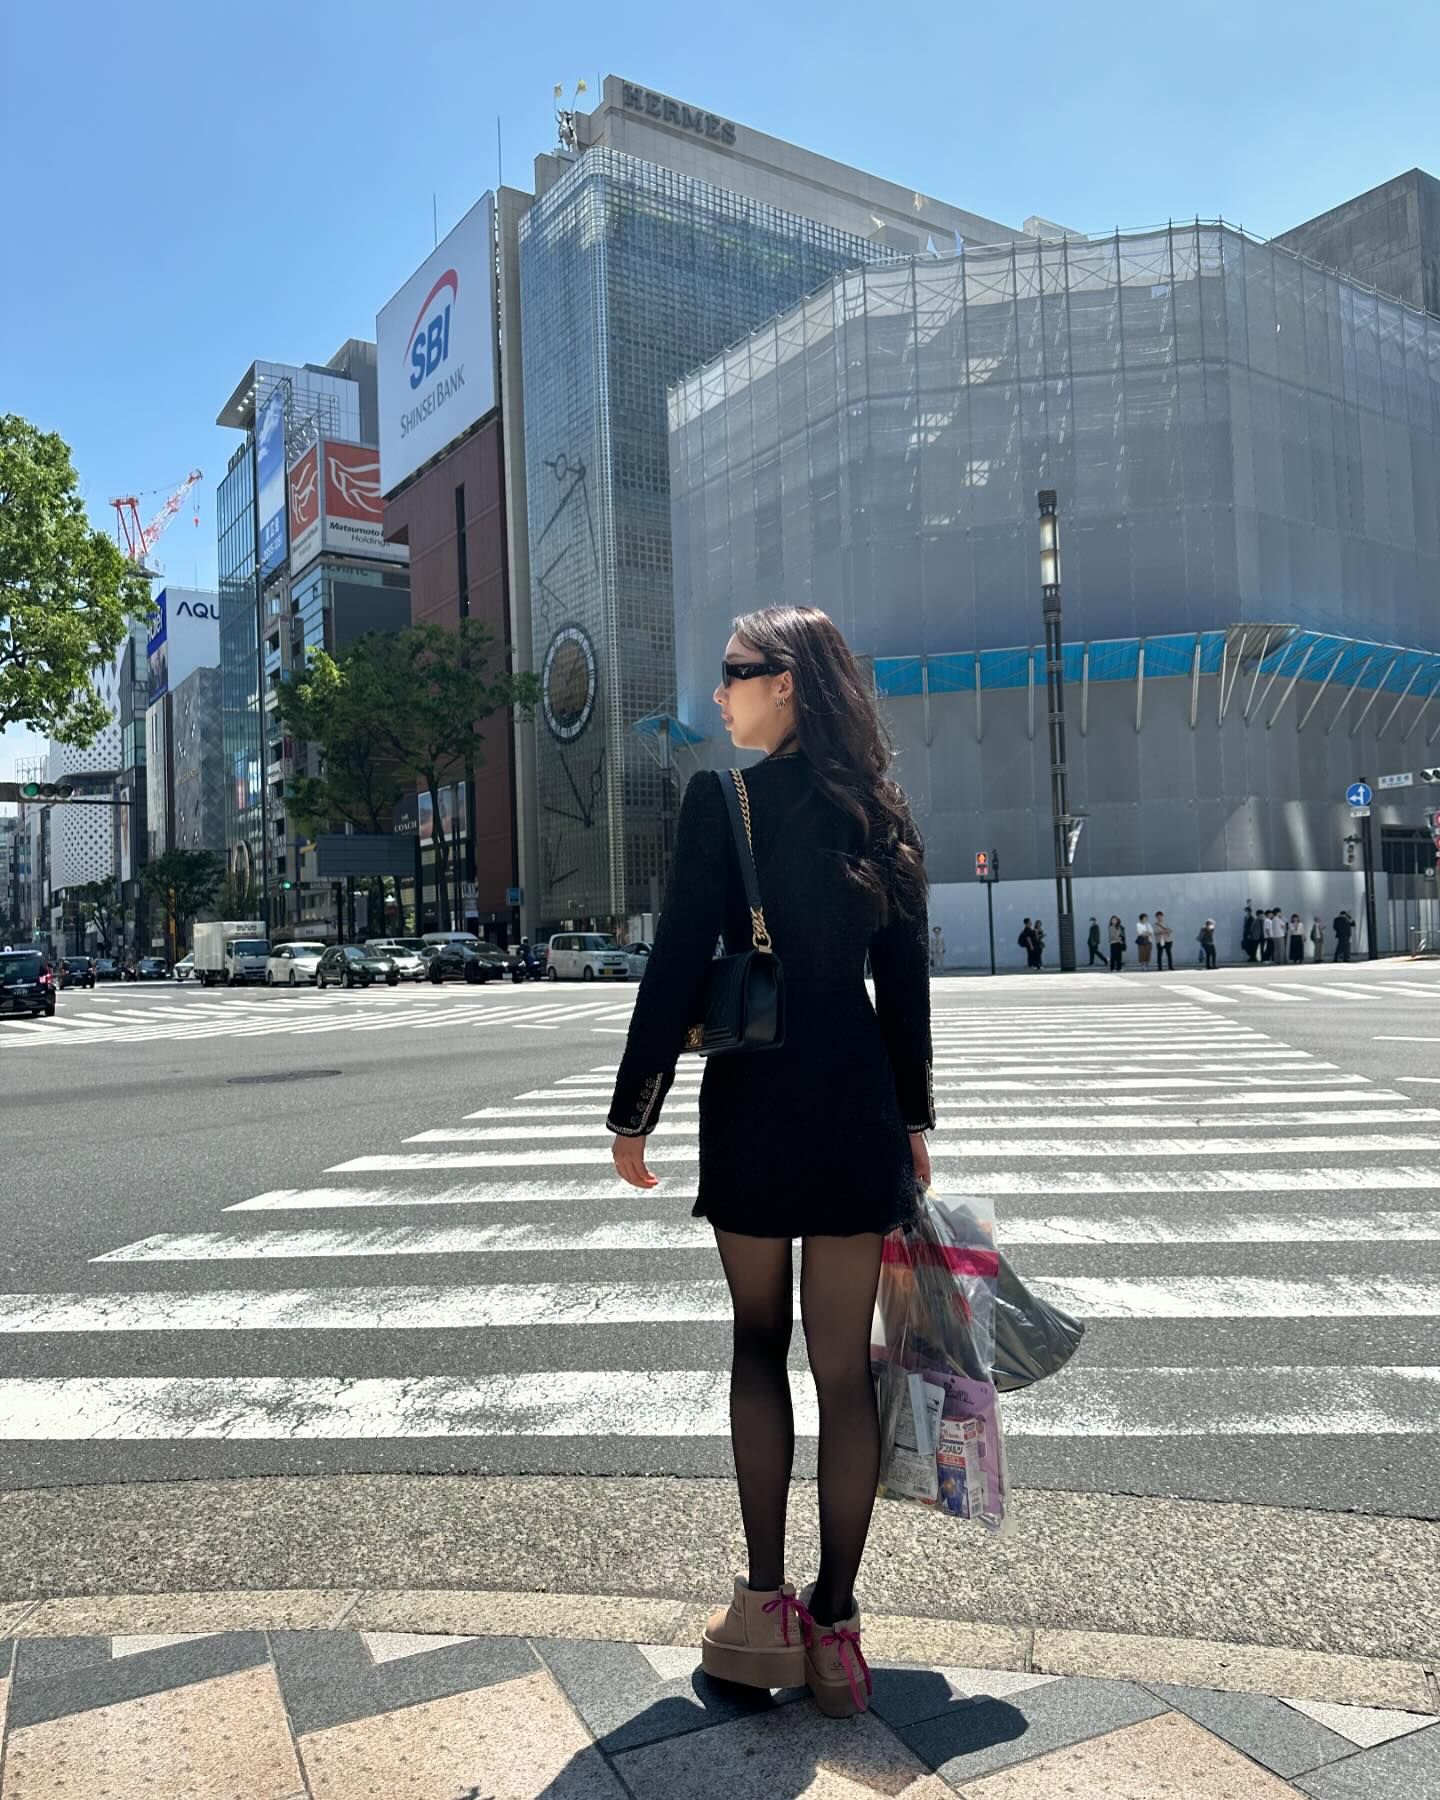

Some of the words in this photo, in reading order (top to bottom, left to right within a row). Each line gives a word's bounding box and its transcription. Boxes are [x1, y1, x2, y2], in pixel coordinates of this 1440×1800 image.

[410, 303, 451, 390] SBI
[400, 394, 437, 439] SHINSEI
[436, 363, 465, 408] BANK
[330, 522, 380, 537] Matsumoto
[394, 819, 417, 833] COACH
